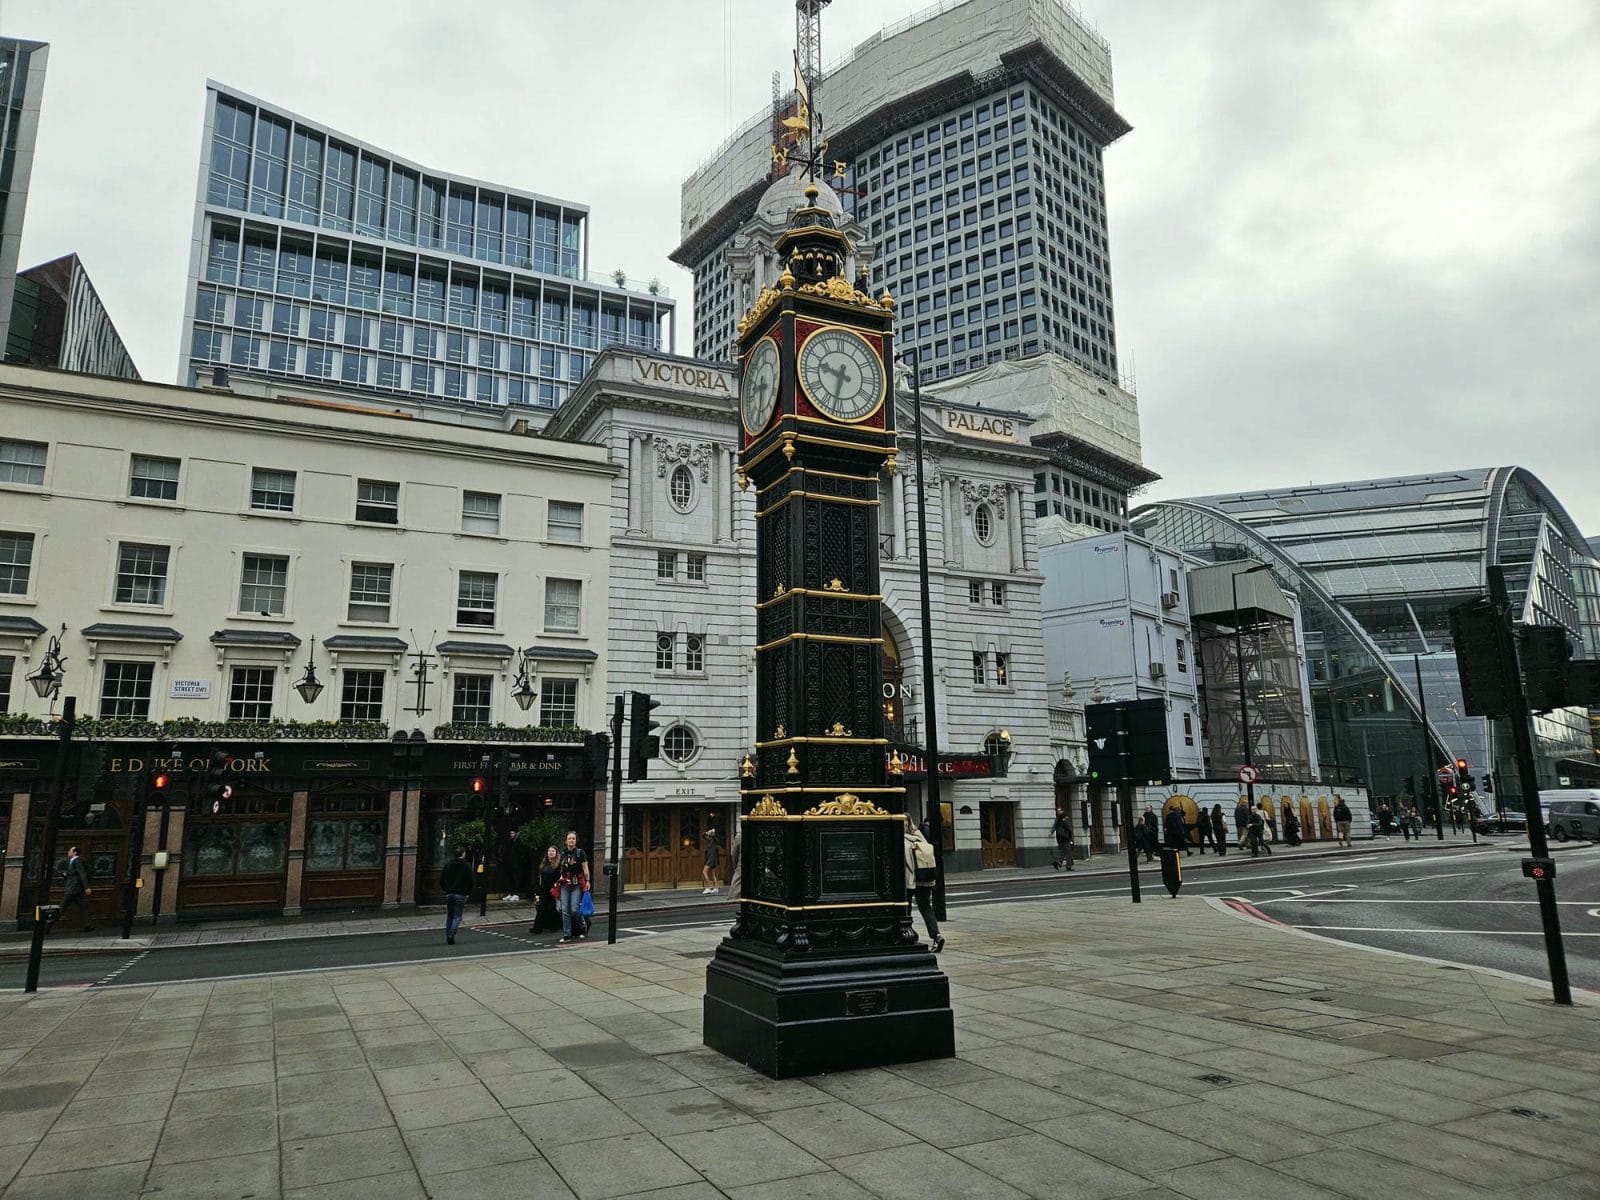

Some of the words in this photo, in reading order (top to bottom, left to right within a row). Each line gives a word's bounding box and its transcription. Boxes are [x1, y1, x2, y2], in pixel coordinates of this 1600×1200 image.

[833, 160, 847, 178] E
[636, 360, 730, 391] VICTORIA
[947, 411, 1014, 437] PALACE
[453, 761, 477, 769] FIRST
[900, 752, 953, 773] PALCE
